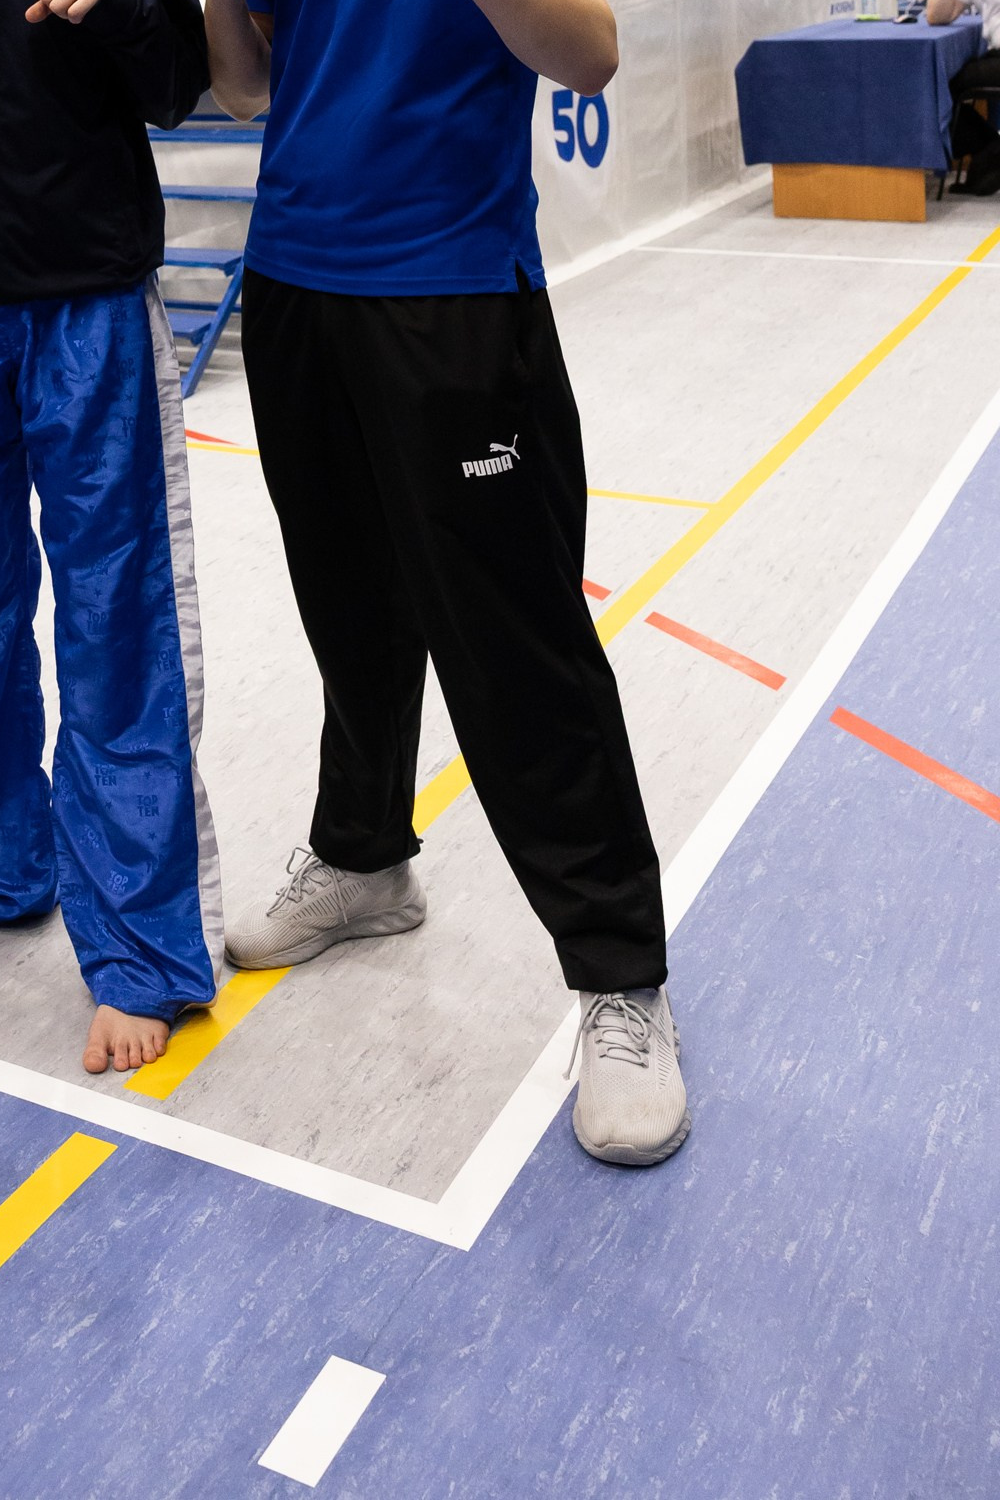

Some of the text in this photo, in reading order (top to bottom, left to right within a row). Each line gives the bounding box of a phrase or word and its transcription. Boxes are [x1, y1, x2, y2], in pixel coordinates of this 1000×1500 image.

[552, 88, 610, 169] 50
[462, 454, 513, 478] PUMA
[95, 775, 117, 786] TEN
[137, 795, 158, 806] TOP
[138, 806, 159, 817] TEN
